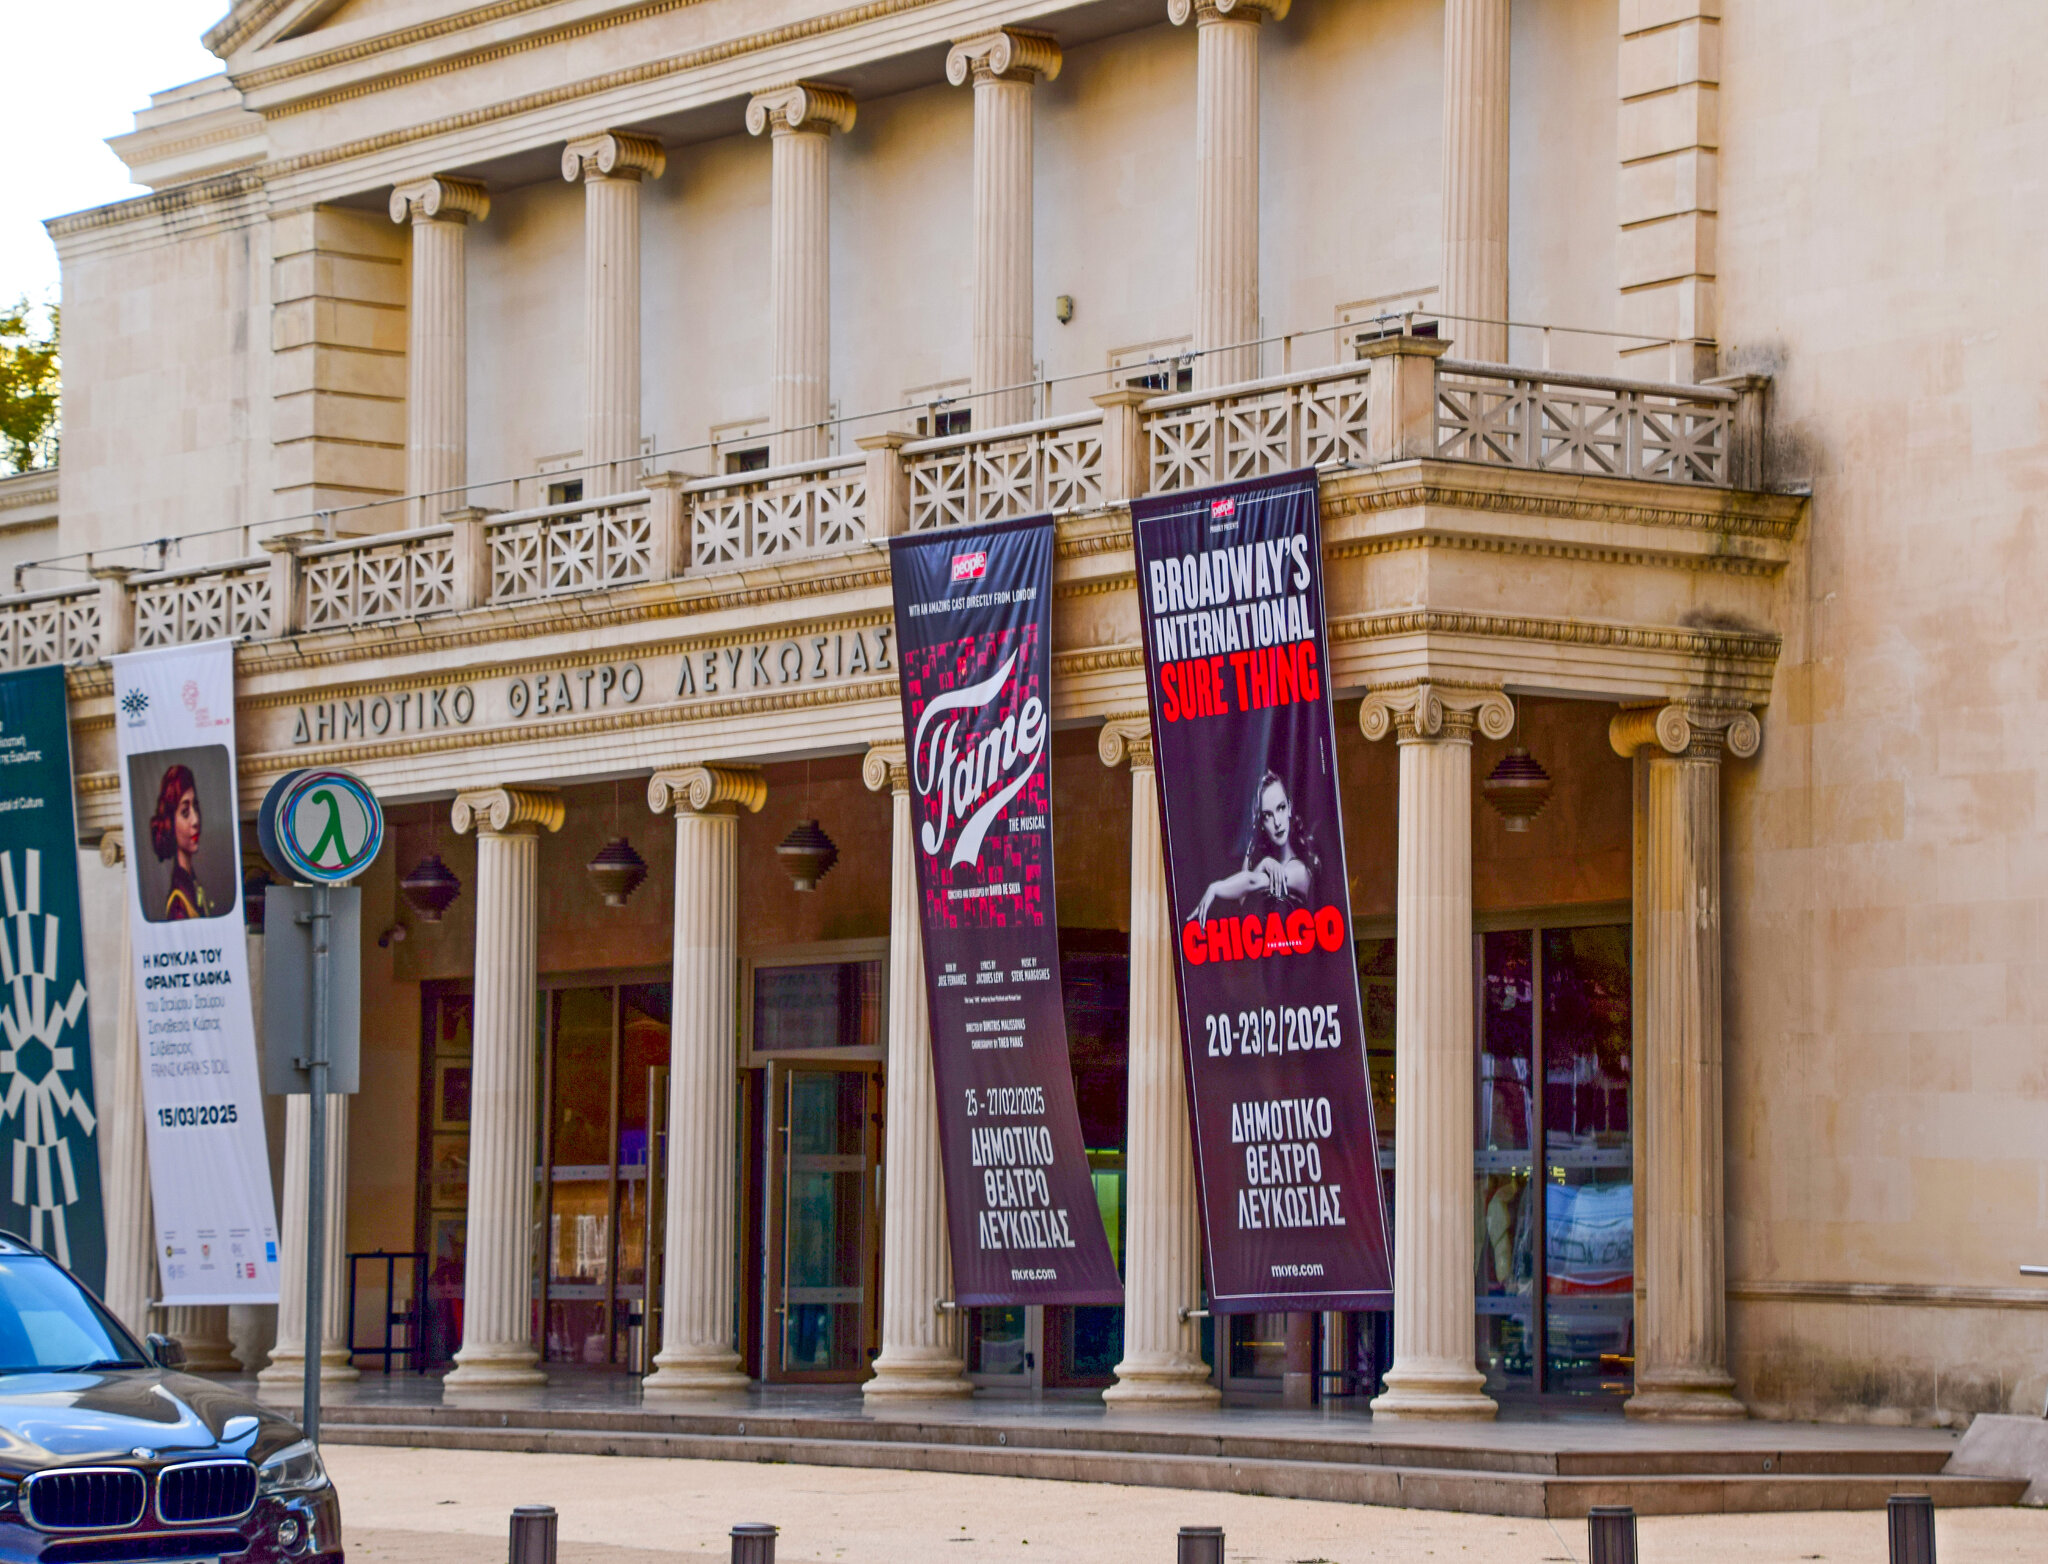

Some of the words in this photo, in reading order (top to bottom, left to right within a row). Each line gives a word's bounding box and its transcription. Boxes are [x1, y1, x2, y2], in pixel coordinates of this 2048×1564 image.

[954, 552, 985, 578] people
[1150, 533, 1310, 614] BROADWAY'S
[908, 604, 920, 618] WITH
[921, 604, 928, 616] AN
[929, 600, 950, 614] AMAZING
[952, 598, 966, 611] CAST
[967, 593, 992, 609] DIRECTLY
[994, 590, 1011, 605] FROM
[1155, 593, 1315, 663] INTERNATIONAL
[292, 684, 475, 744] ΔΗΜΟΤΙΚΟ
[506, 662, 643, 718] ΘΕΑΤΡΟ
[675, 627, 892, 696] ΛΕΥΚΩΣΙΑΣ
[1160, 655, 1228, 723] SURE
[1230, 640, 1320, 712] THING
[914, 648, 1046, 870] Fame
[1009, 818, 1020, 832] THE
[1021, 815, 1045, 830] MUSICAL
[1182, 904, 1344, 966] CHICAGO
[143, 955, 151, 968] Η
[153, 951, 198, 968] ΚΟΥΚΛΑ
[200, 948, 222, 963] ΤΟΥ
[145, 973, 191, 990] ΦΡΑΝΤΣ
[193, 970, 232, 986] ΚΑΦΚΑ
[158, 1104, 238, 1127] 15/03/2025
[965, 1088, 978, 1116] 25
[987, 1087, 1045, 1116] 27/02/2025
[1232, 1097, 1332, 1143] ΔΗΜΟΤΙΚΟ
[971, 1125, 1054, 1167] ΔΗΜΟΤΙΚΟ
[1246, 1142, 1322, 1186] ΘΕΑΤΡΟ
[984, 1168, 1050, 1208] ΘΕΑΤΡΟ
[1238, 1184, 1346, 1230] ΛΕΥΚΩΣΙΑΣ
[979, 1209, 1075, 1250] ΛΕΥΚΩΣΙΑΣ
[1011, 1268, 1056, 1281] more.com
[1271, 1264, 1324, 1278] more.com
